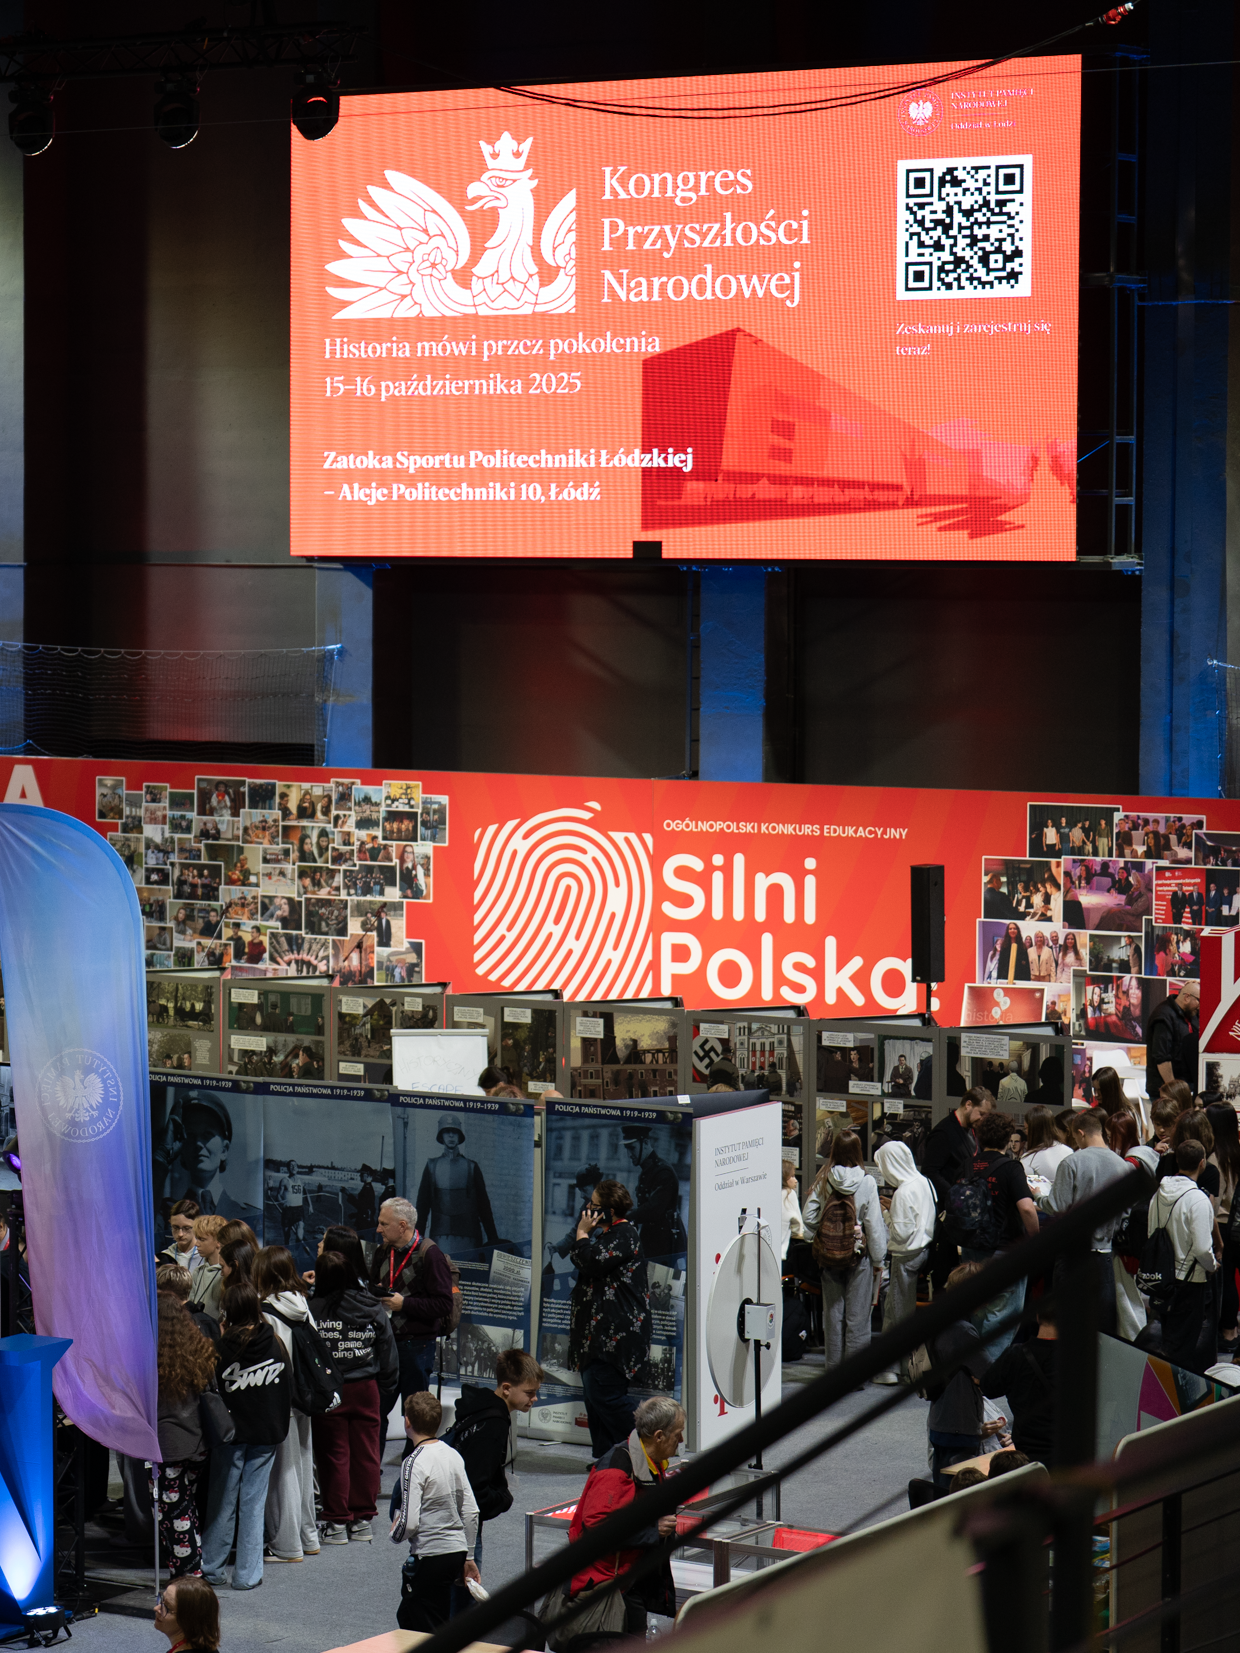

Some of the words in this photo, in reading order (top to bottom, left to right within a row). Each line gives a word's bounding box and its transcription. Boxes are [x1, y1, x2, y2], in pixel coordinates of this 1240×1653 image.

[601, 166, 753, 206] Kongres
[601, 209, 810, 258] Przyszłości
[601, 261, 801, 307] Narodowej
[896, 322, 954, 336] Zeskanuj
[956, 322, 961, 333] i
[963, 320, 1031, 335] zarejestruj
[1034, 319, 1052, 335] się
[324, 338, 410, 359] Historia
[416, 334, 476, 357] mówi
[483, 339, 544, 361] przez
[549, 331, 661, 361] pokolenia
[896, 343, 931, 355] teraz!
[324, 375, 376, 397] 15–16
[380, 373, 523, 402] października
[528, 371, 582, 395] 2025
[323, 450, 393, 469] Zatoka
[396, 450, 465, 474] Sportu
[469, 448, 596, 469] Politechniki
[599, 447, 694, 473] Łódzkiej
[338, 482, 388, 506] Aleje
[392, 482, 516, 502] Politechniki
[520, 482, 546, 504] 10,
[549, 482, 601, 502] Łódź
[663, 817, 758, 833] OGÓLNOPOLSKI
[761, 822, 820, 836] KONKURS
[823, 825, 908, 839] EDUKACYJNY
[661, 852, 817, 925] Silni
[167, 1075, 202, 1086] PAŃSTWOWA
[203, 1079, 232, 1088] 1919–1939
[270, 1085, 294, 1094] POLICJA
[295, 1085, 332, 1095] PAŃSTWOWA
[333, 1088, 365, 1097] 1919–1939
[399, 1096, 424, 1106] POLICJA
[425, 1097, 464, 1108] PAŃSTWOWA
[466, 1101, 499, 1111] 1919–1939
[554, 1104, 580, 1114] POLICJA
[581, 1105, 621, 1117] PAŃSTWOWA
[622, 1110, 657, 1120] 1919–1939
[714, 1141, 742, 1157] INSTYTUT
[742, 1136, 764, 1150] PAMIĘCI
[714, 1152, 749, 1169] NARODOWEJ
[291, 1184, 303, 1195] 156
[714, 1178, 734, 1192] Oddział
[740, 1171, 768, 1185] Warszawie
[315, 1319, 343, 1330] Living
[319, 1330, 343, 1340] ibes,
[337, 1340, 365, 1350] game.
